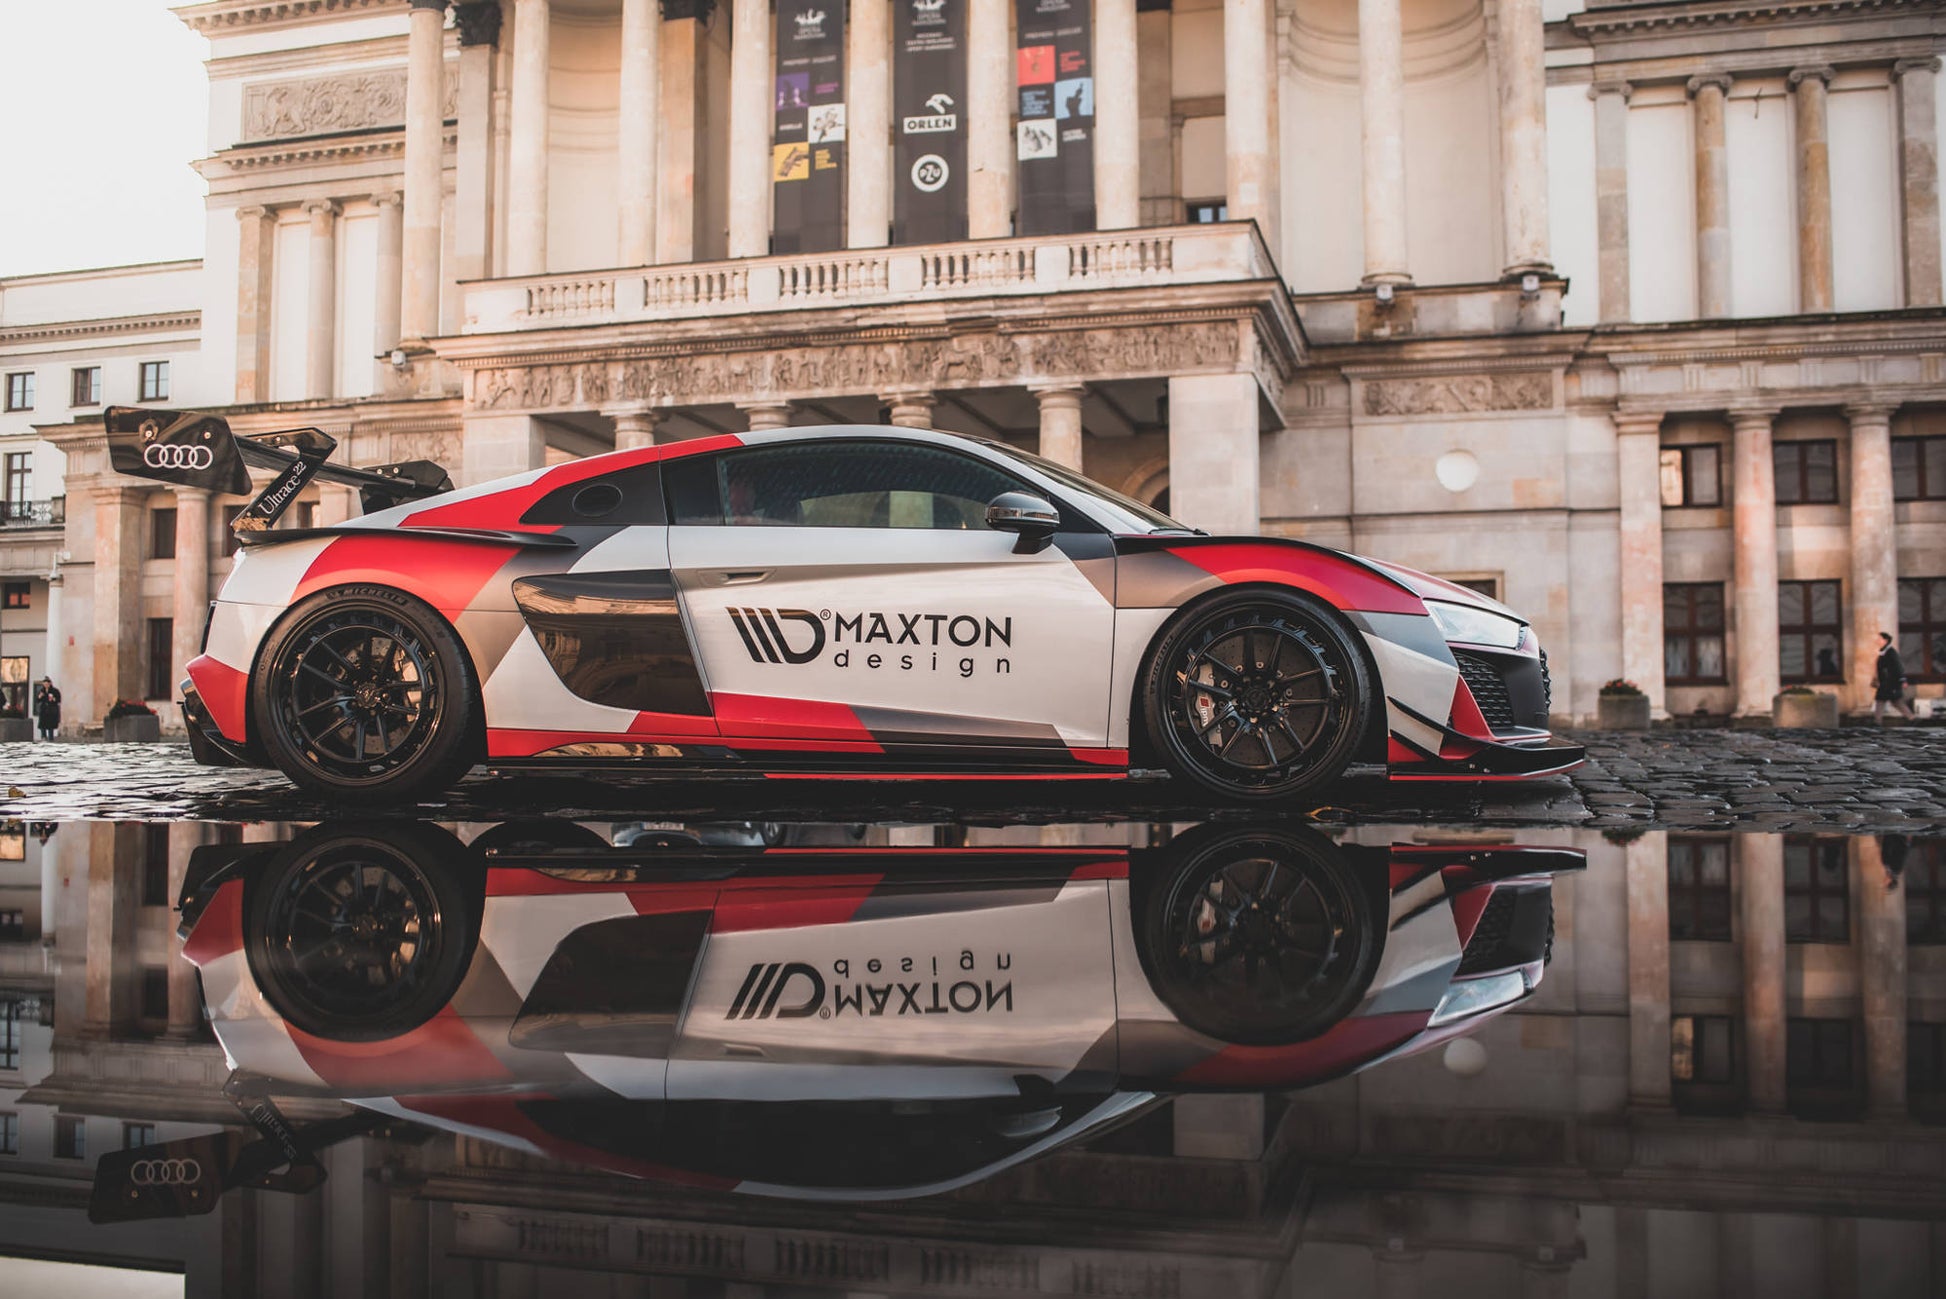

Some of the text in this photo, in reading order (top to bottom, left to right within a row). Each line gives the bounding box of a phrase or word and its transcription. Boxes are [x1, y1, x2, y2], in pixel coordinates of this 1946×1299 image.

[907, 119, 952, 130] ORLEN
[919, 164, 941, 182] PZU
[343, 587, 406, 606] MICHELIN
[834, 611, 1012, 648] MAXTON
[834, 649, 1010, 677] design
